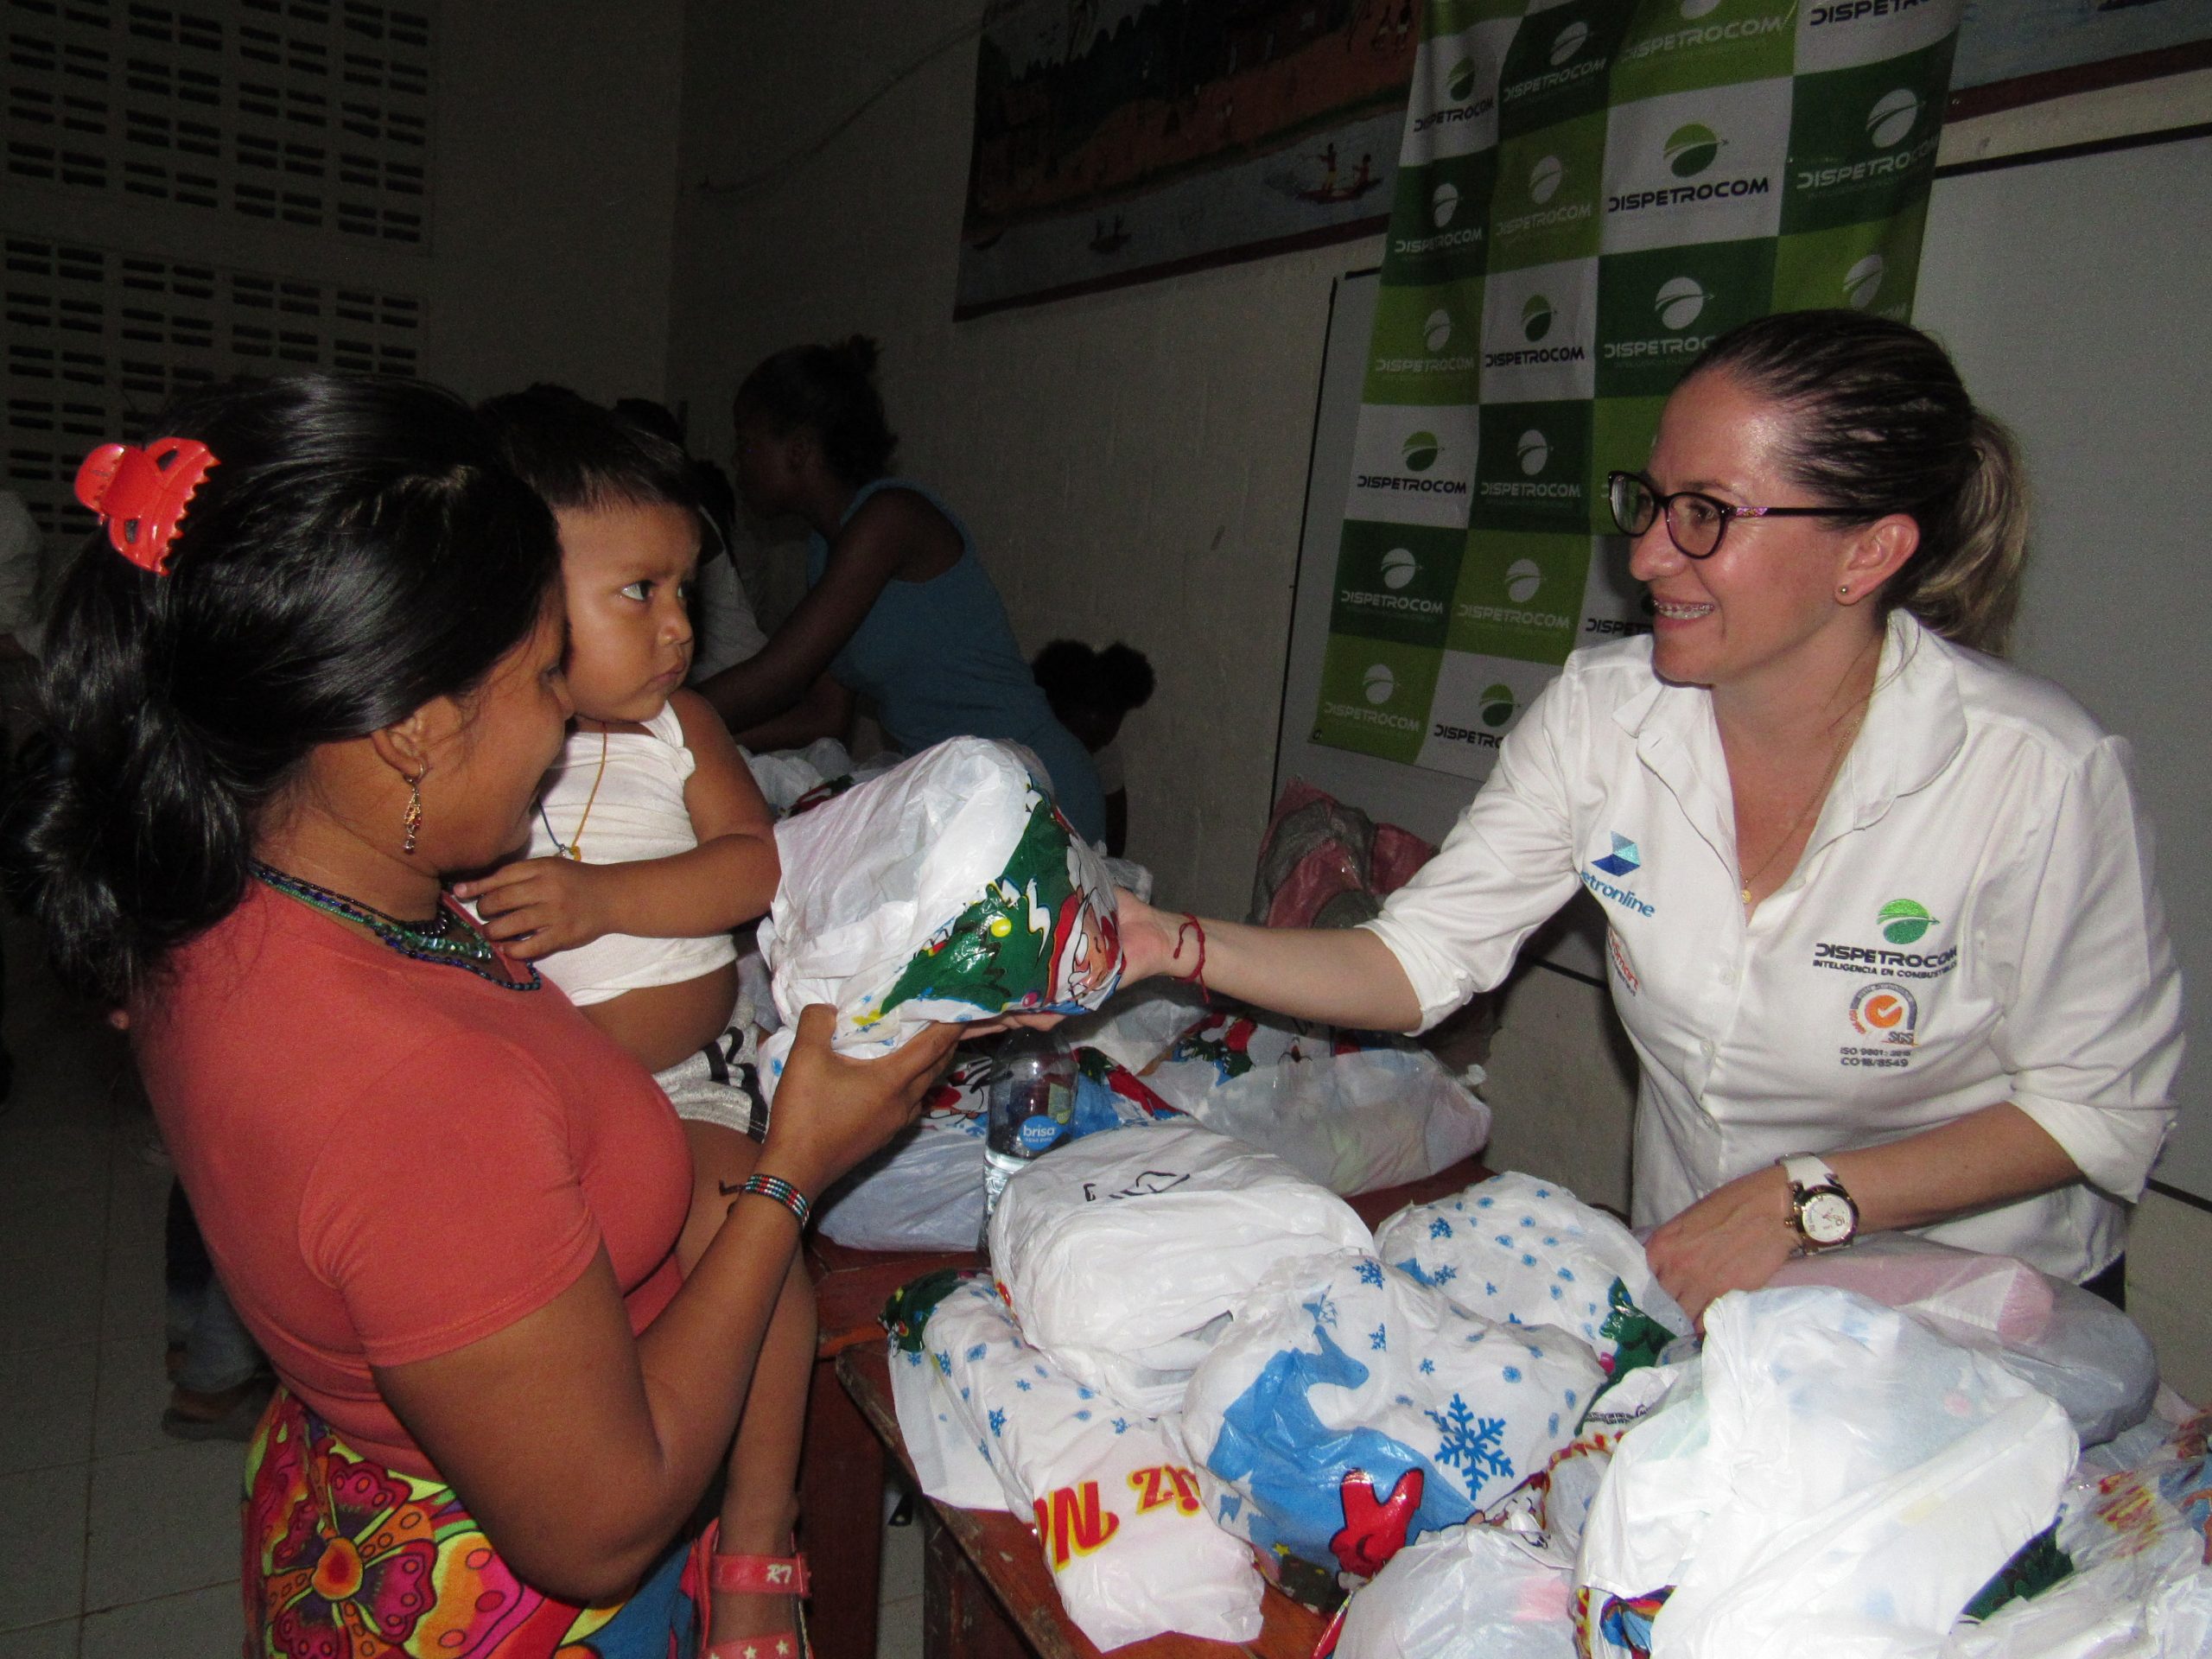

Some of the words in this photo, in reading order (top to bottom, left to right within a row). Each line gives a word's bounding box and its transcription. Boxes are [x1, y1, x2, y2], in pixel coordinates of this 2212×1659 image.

[1503, 58, 1607, 102] DISPETROCOM
[1609, 178, 1769, 213] DISPETROCOM
[1496, 204, 1592, 236] DISPETROCOM
[1376, 358, 1474, 373] DISPETROCOM
[1485, 347, 1585, 367] DISPETROCOM
[1357, 475, 1466, 494] DISPETROCOM
[1481, 481, 1580, 499] DISPETROCOM
[1340, 590, 1444, 614] DISPETROCOM
[1457, 604, 1571, 630] DISPETROCOM
[1323, 701, 1420, 733] DISPETROCOM
[1580, 870, 1655, 918] etronline
[1023, 1124, 1055, 1137] brisa
